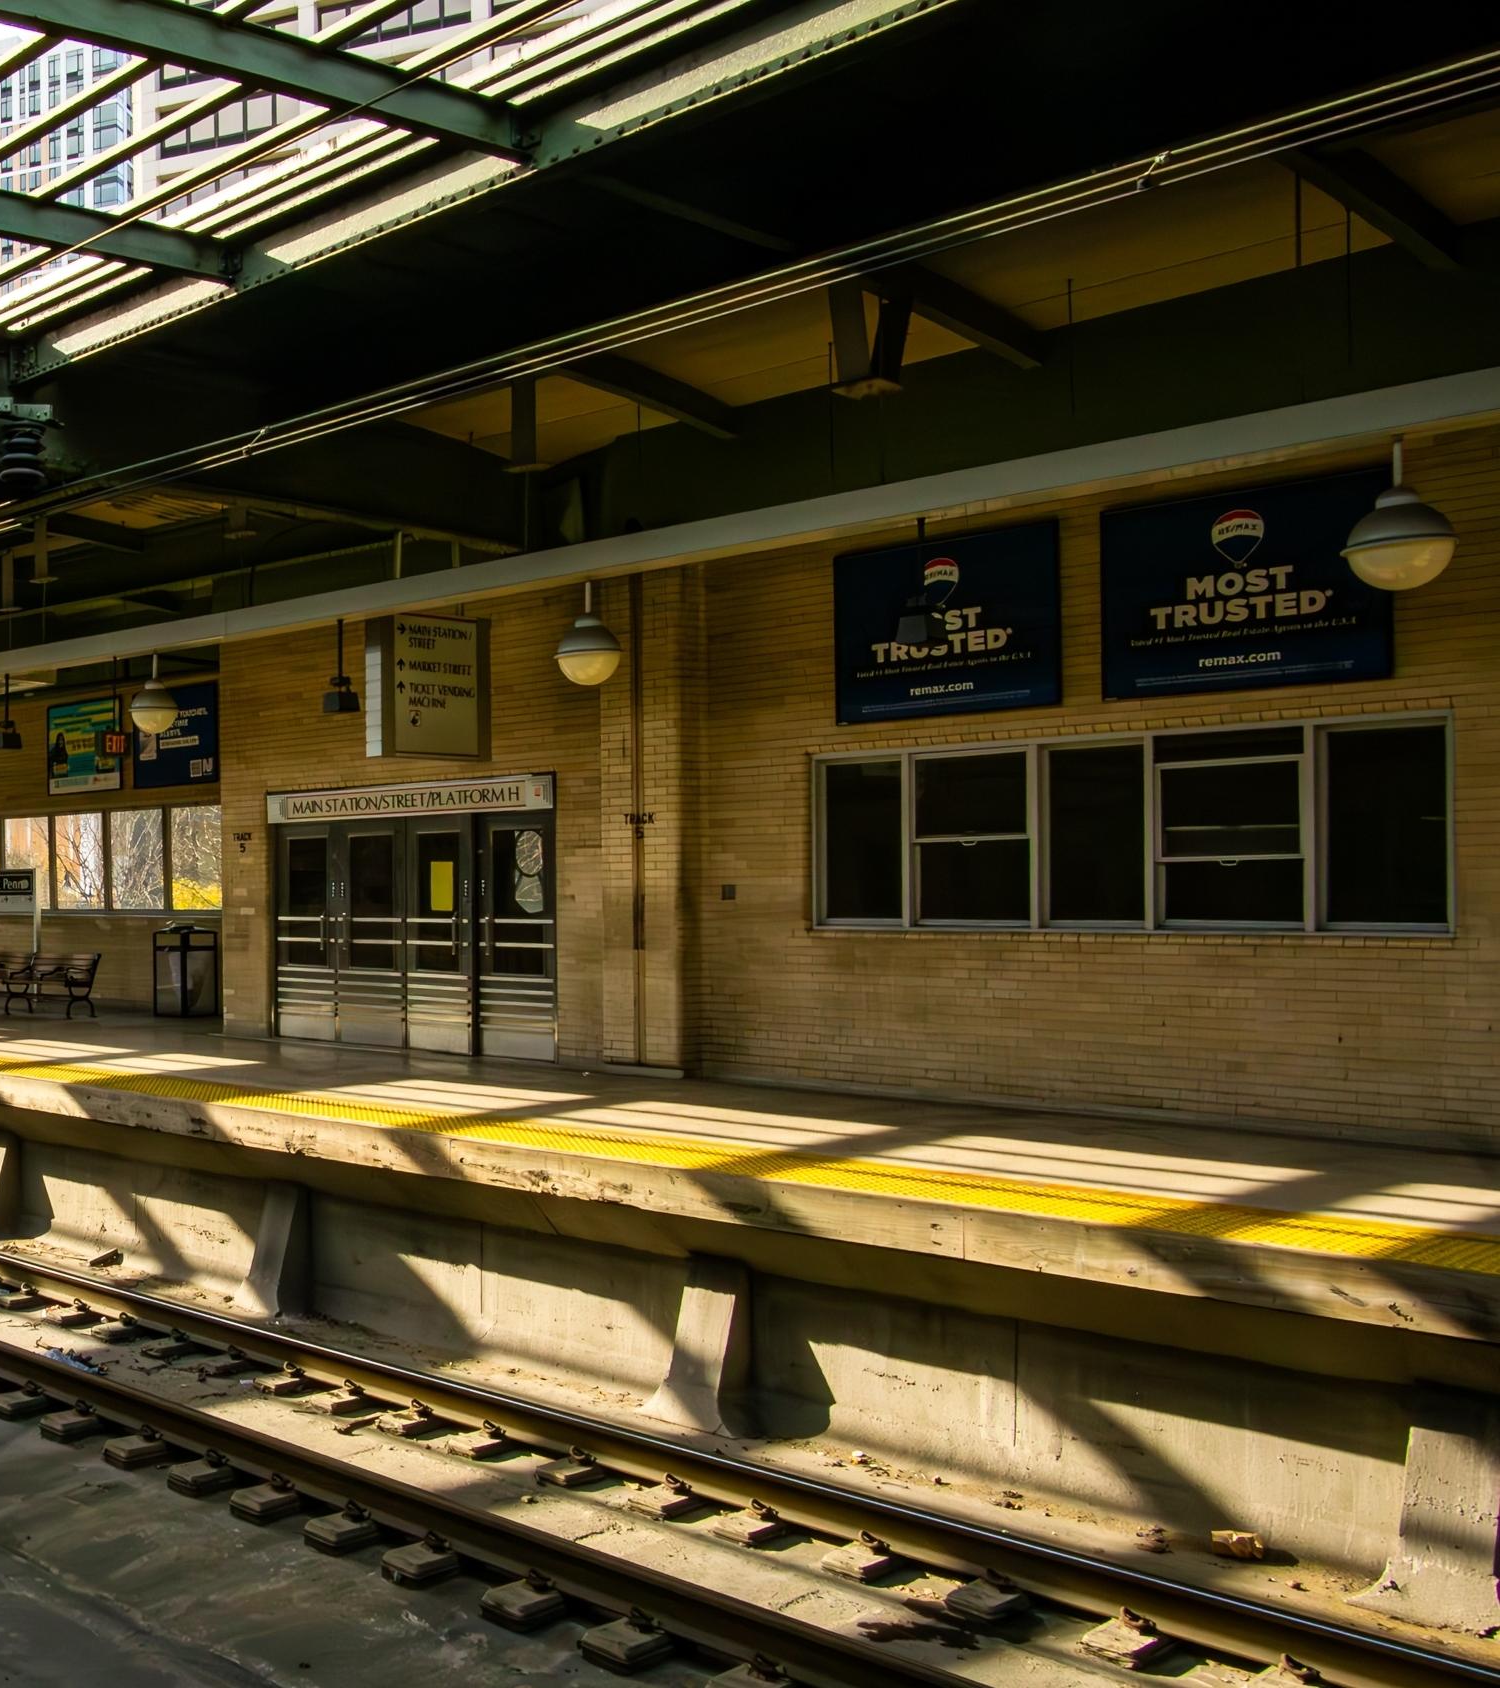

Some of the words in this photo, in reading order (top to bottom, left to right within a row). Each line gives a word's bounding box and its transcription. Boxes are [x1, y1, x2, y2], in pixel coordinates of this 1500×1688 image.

[1186, 564, 1294, 600] MOST
[433, 626, 467, 640] STATION
[408, 637, 436, 649] STREET
[1199, 651, 1281, 668] remax.com
[409, 660, 440, 672] MARKET
[443, 663, 471, 676] STREET
[409, 682, 436, 695] TICKET
[437, 685, 475, 698] VENDING
[910, 681, 974, 696] remax.com
[409, 696, 446, 709] MACHINE
[106, 735, 126, 753] EXIT
[292, 798, 324, 815] MAIN
[325, 788, 505, 813] STATION/STREET/PLATFORM
[508, 786, 519, 801] H
[624, 812, 654, 824] TRACK
[233, 832, 252, 840] TRACK
[240, 843, 246, 853] 5
